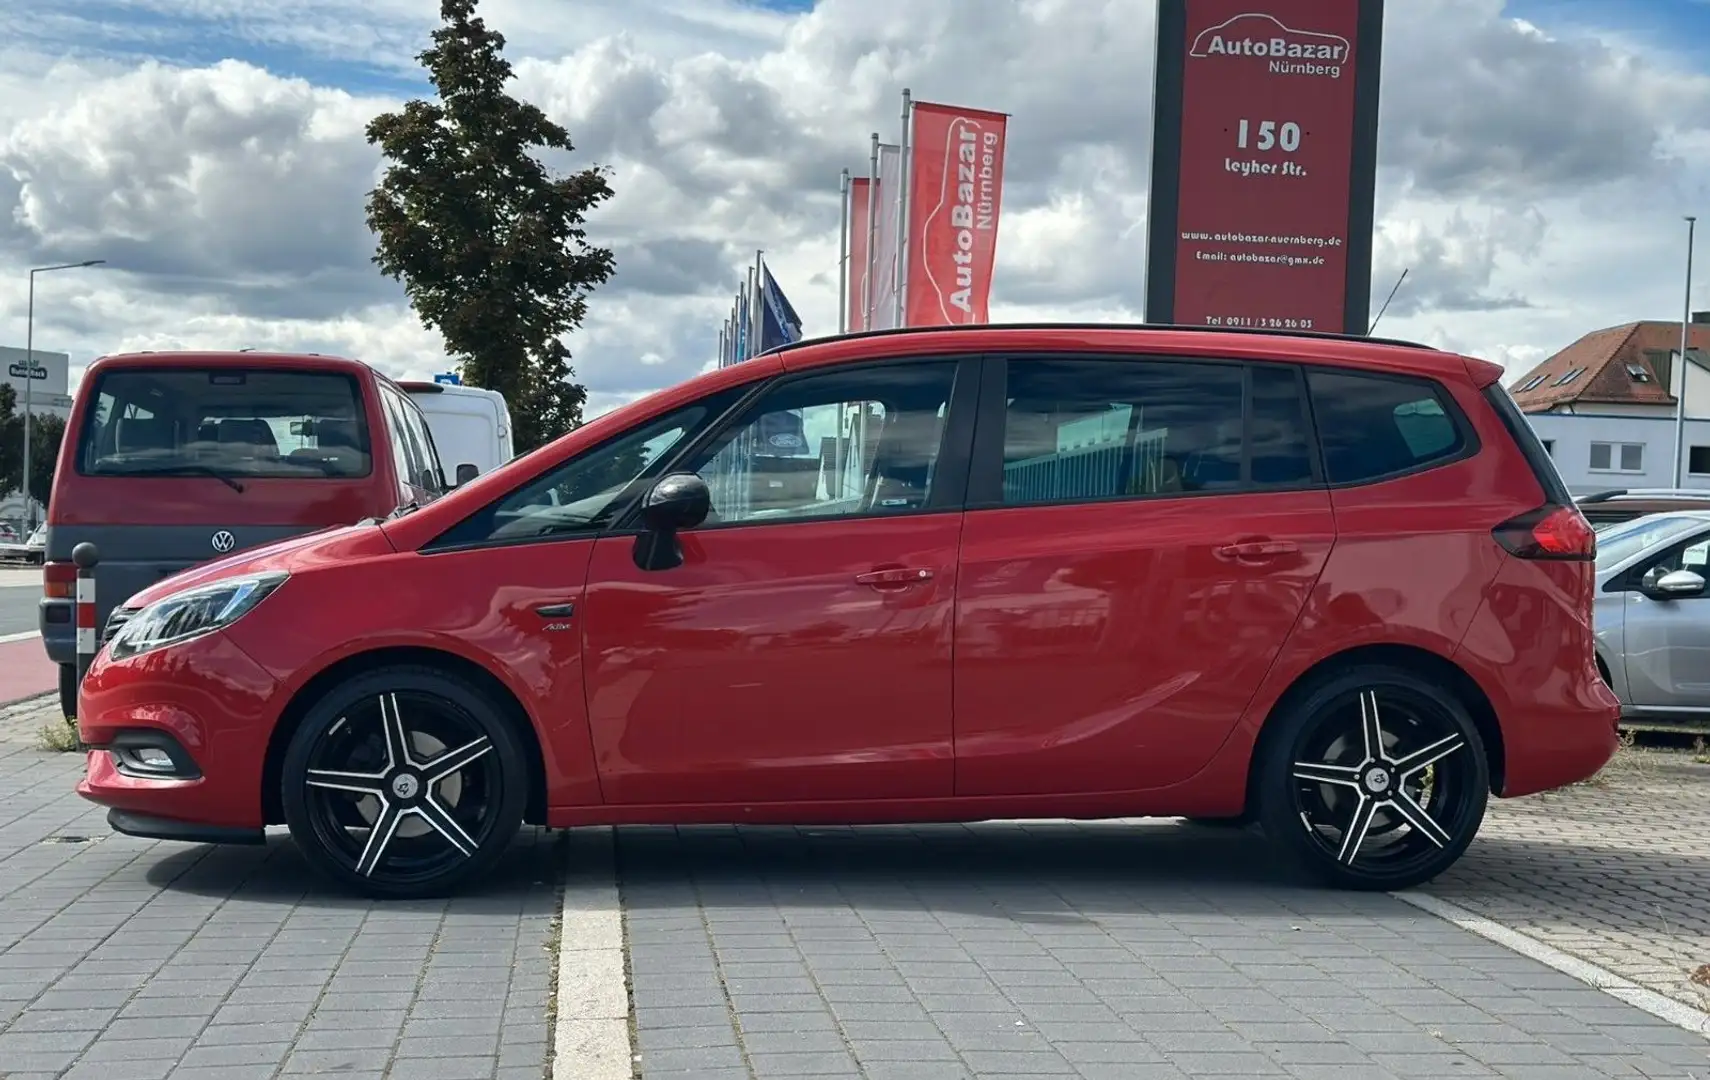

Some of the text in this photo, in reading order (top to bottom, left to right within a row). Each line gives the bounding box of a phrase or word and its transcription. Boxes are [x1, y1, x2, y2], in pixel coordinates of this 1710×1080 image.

[1208, 36, 1343, 60] AutoBazar
[1269, 61, 1340, 78] Nürnberg
[1238, 119, 1300, 151] 150
[1281, 161, 1307, 176] Str.
[976, 131, 998, 230] Nürnberg
[950, 126, 977, 312] AutoBazar
[1196, 251, 1227, 261] Email:
[1206, 316, 1221, 325] Tel
